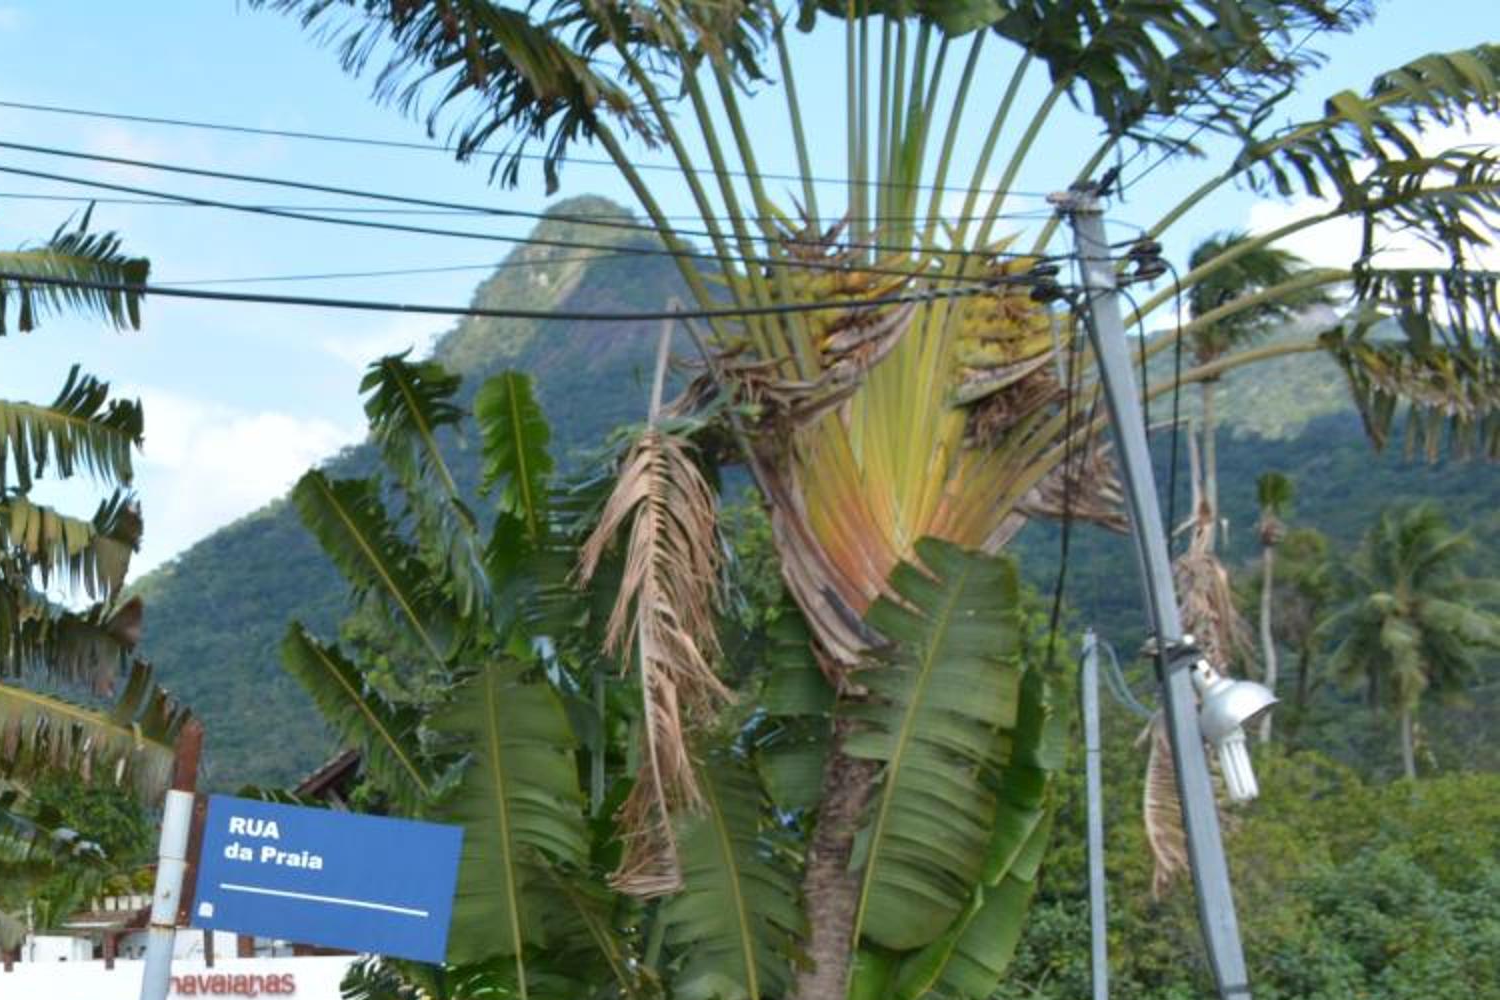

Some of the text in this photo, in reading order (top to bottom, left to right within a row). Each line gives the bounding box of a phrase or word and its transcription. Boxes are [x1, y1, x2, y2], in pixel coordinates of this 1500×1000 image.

[229, 816, 280, 840] RUA
[224, 842, 323, 870] da Praia
